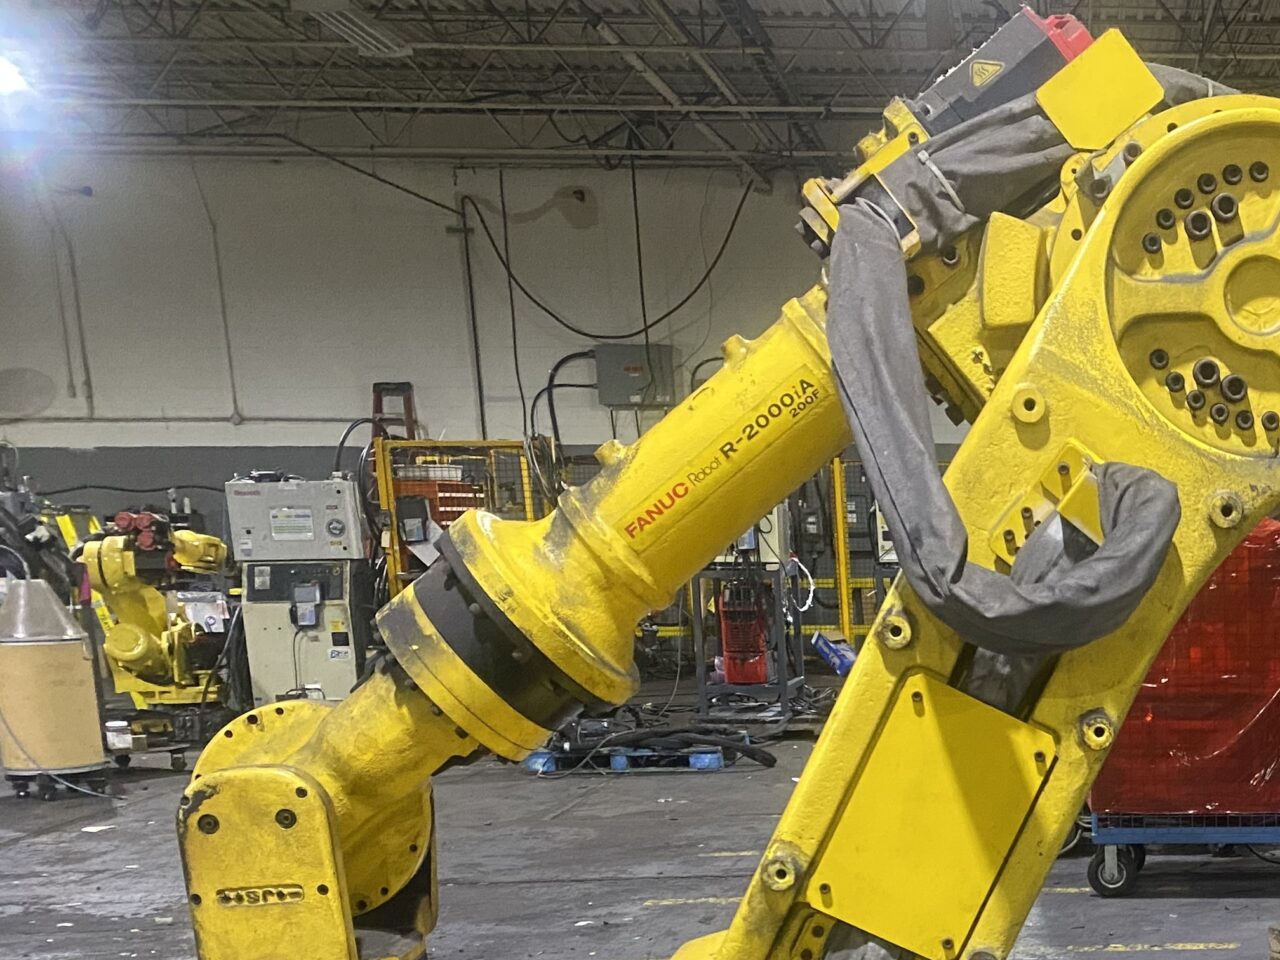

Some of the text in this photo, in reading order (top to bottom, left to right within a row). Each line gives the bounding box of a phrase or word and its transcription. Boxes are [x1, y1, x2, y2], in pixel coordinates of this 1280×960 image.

[789, 388, 821, 418] 200F
[624, 378, 815, 539] FANUC Robot R-2000iA
